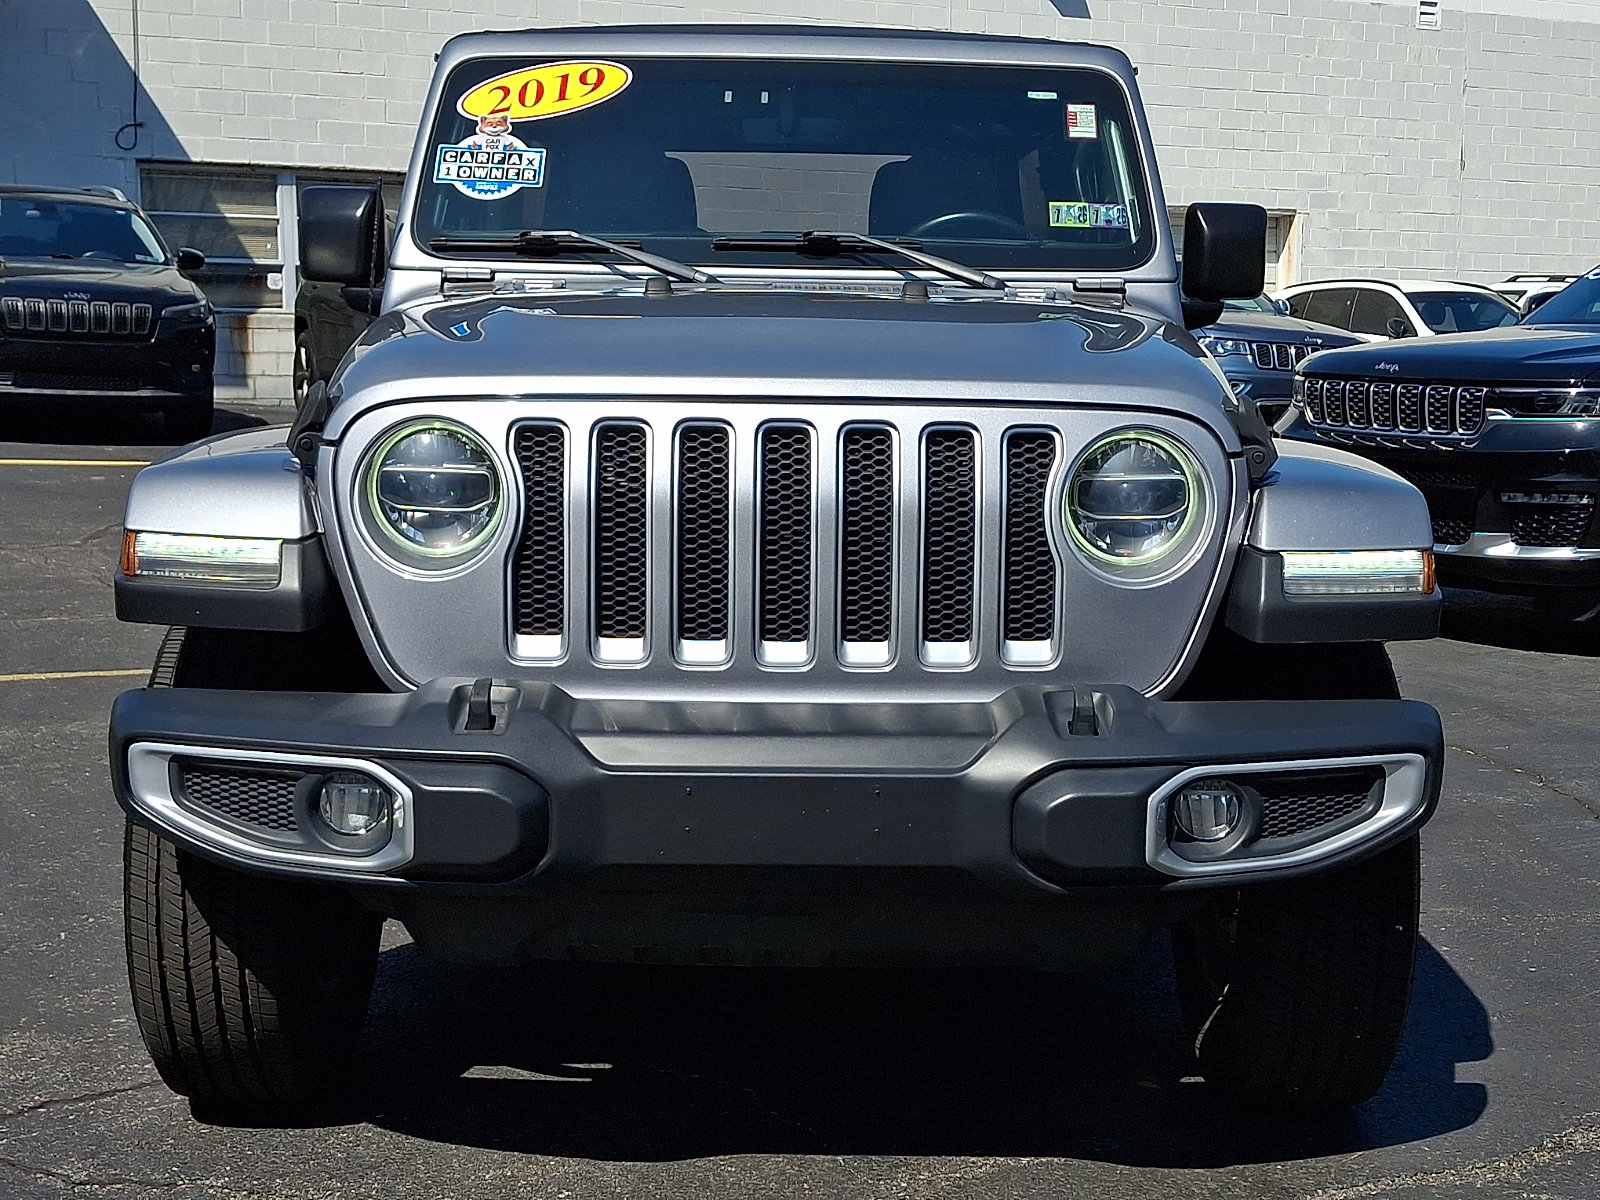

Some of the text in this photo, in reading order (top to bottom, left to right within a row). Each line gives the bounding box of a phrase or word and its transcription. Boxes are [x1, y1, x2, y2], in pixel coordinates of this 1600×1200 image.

[487, 67, 606, 115] 2019
[443, 150, 536, 167] CARFAX
[444, 165, 537, 181] 1 OWNER
